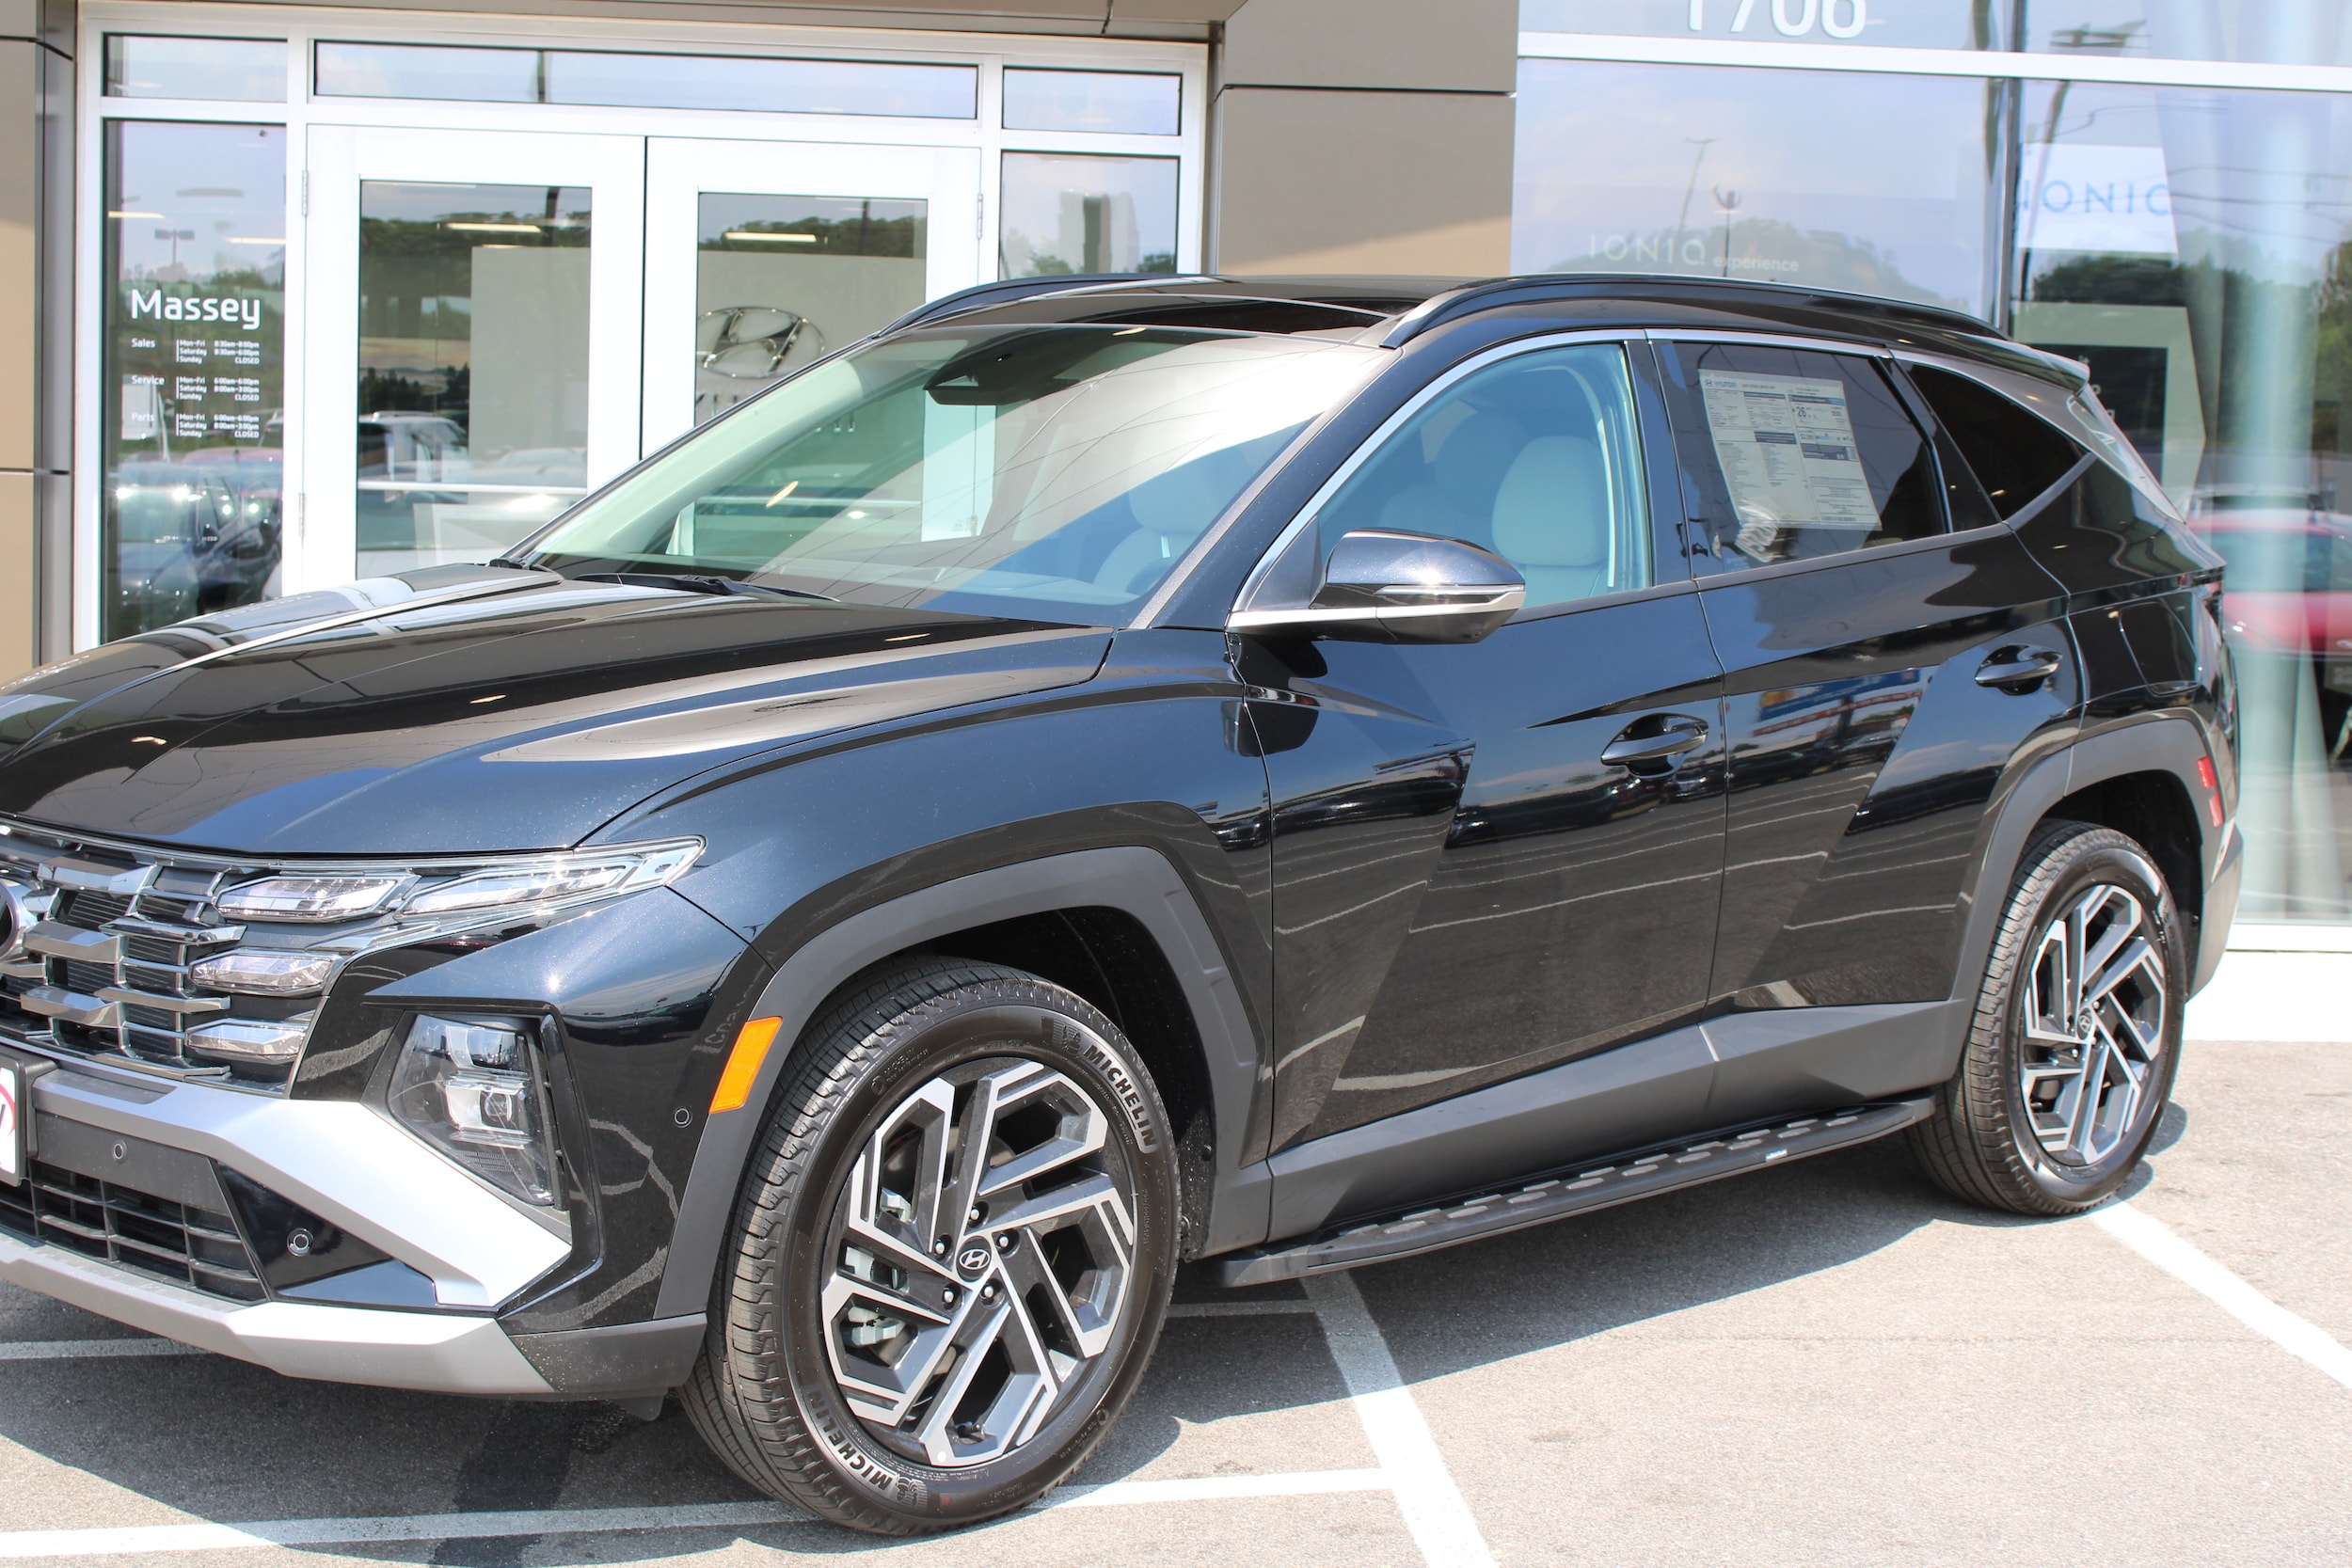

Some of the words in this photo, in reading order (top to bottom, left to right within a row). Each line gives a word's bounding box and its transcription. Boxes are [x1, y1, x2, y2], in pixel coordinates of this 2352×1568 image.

[1589, 233, 1706, 266] IONIQ
[1712, 254, 1800, 272] experience
[131, 289, 261, 330] Massey
[131, 338, 156, 348] Sales
[180, 348, 207, 356] Saturday
[180, 356, 202, 365] Sunday
[131, 375, 165, 387] Service
[180, 385, 207, 393] Saturday
[180, 393, 202, 402] Sunday
[131, 412, 155, 422] Parts
[180, 421, 207, 430] Saturday
[180, 430, 202, 438] Sunday
[1083, 1044, 1156, 1147] MICHELIN
[807, 1390, 893, 1491] MICHELIN
